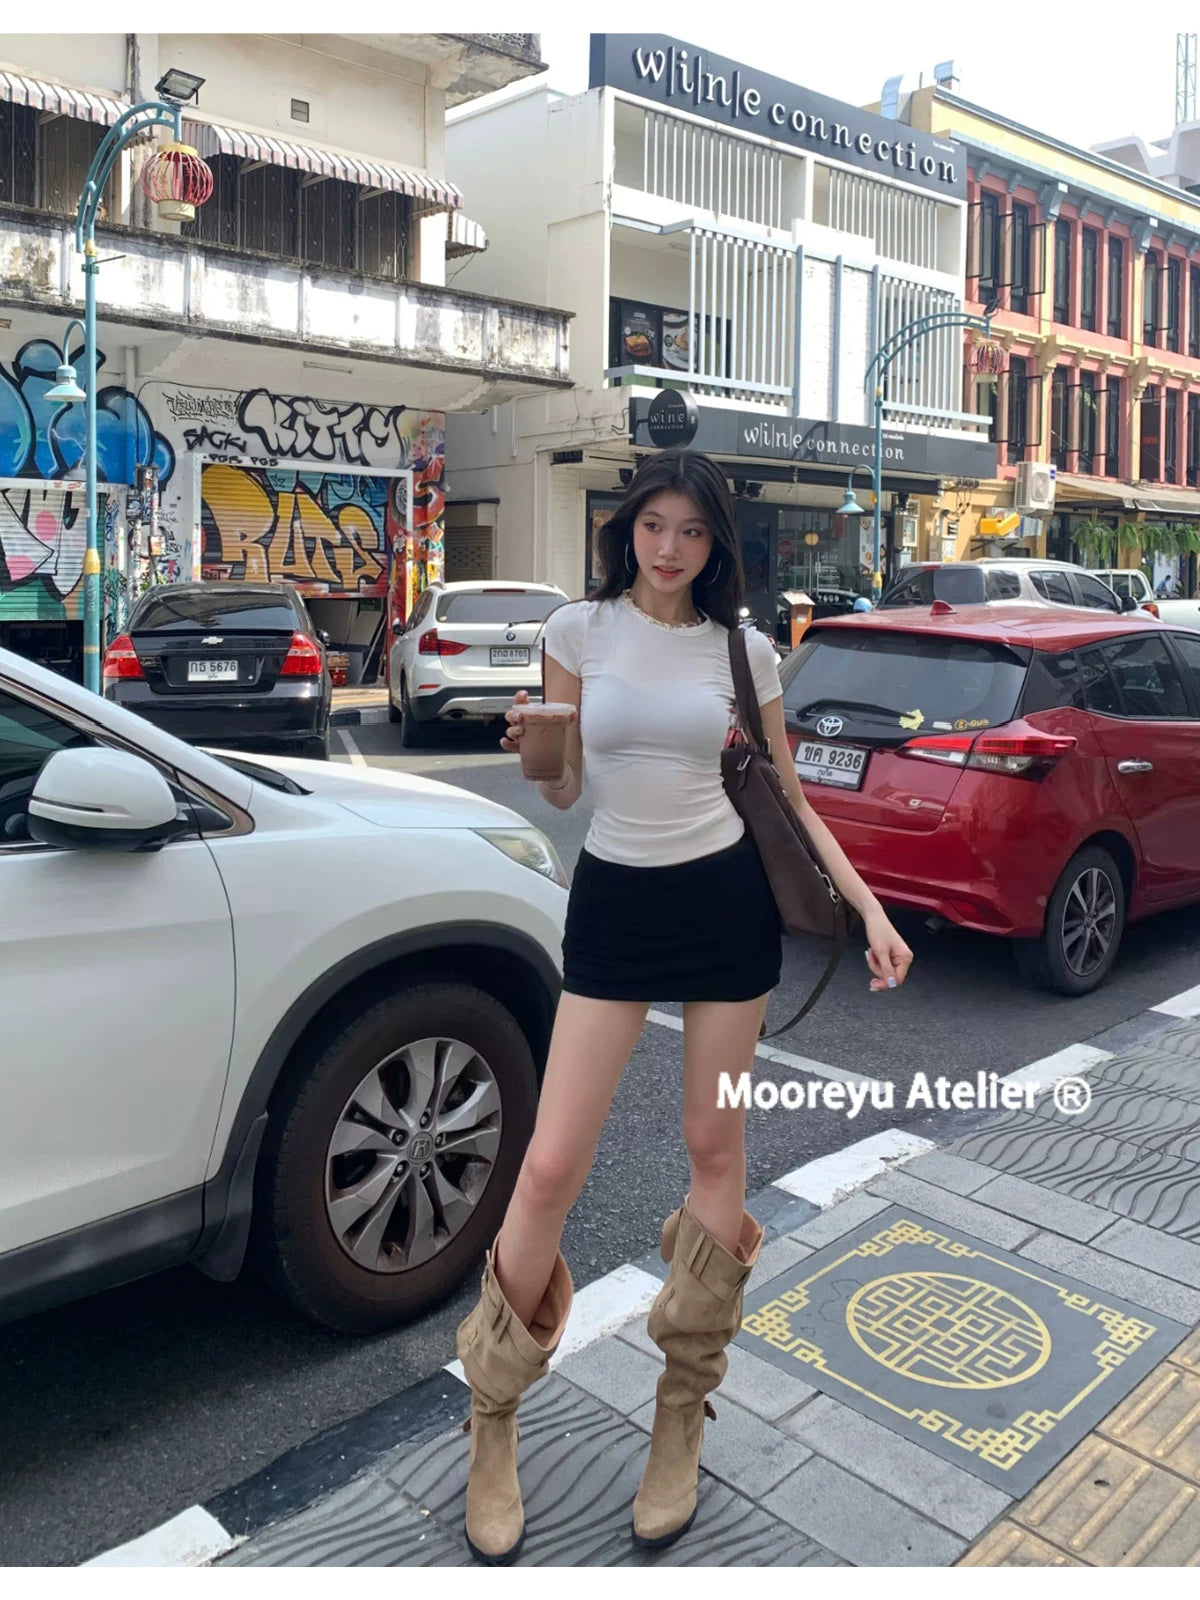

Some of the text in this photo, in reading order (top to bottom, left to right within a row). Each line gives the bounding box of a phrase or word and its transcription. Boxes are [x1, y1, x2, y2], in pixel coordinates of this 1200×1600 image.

[771, 103, 958, 183] connection
[210, 661, 236, 672] 5676
[828, 750, 862, 769] 9236
